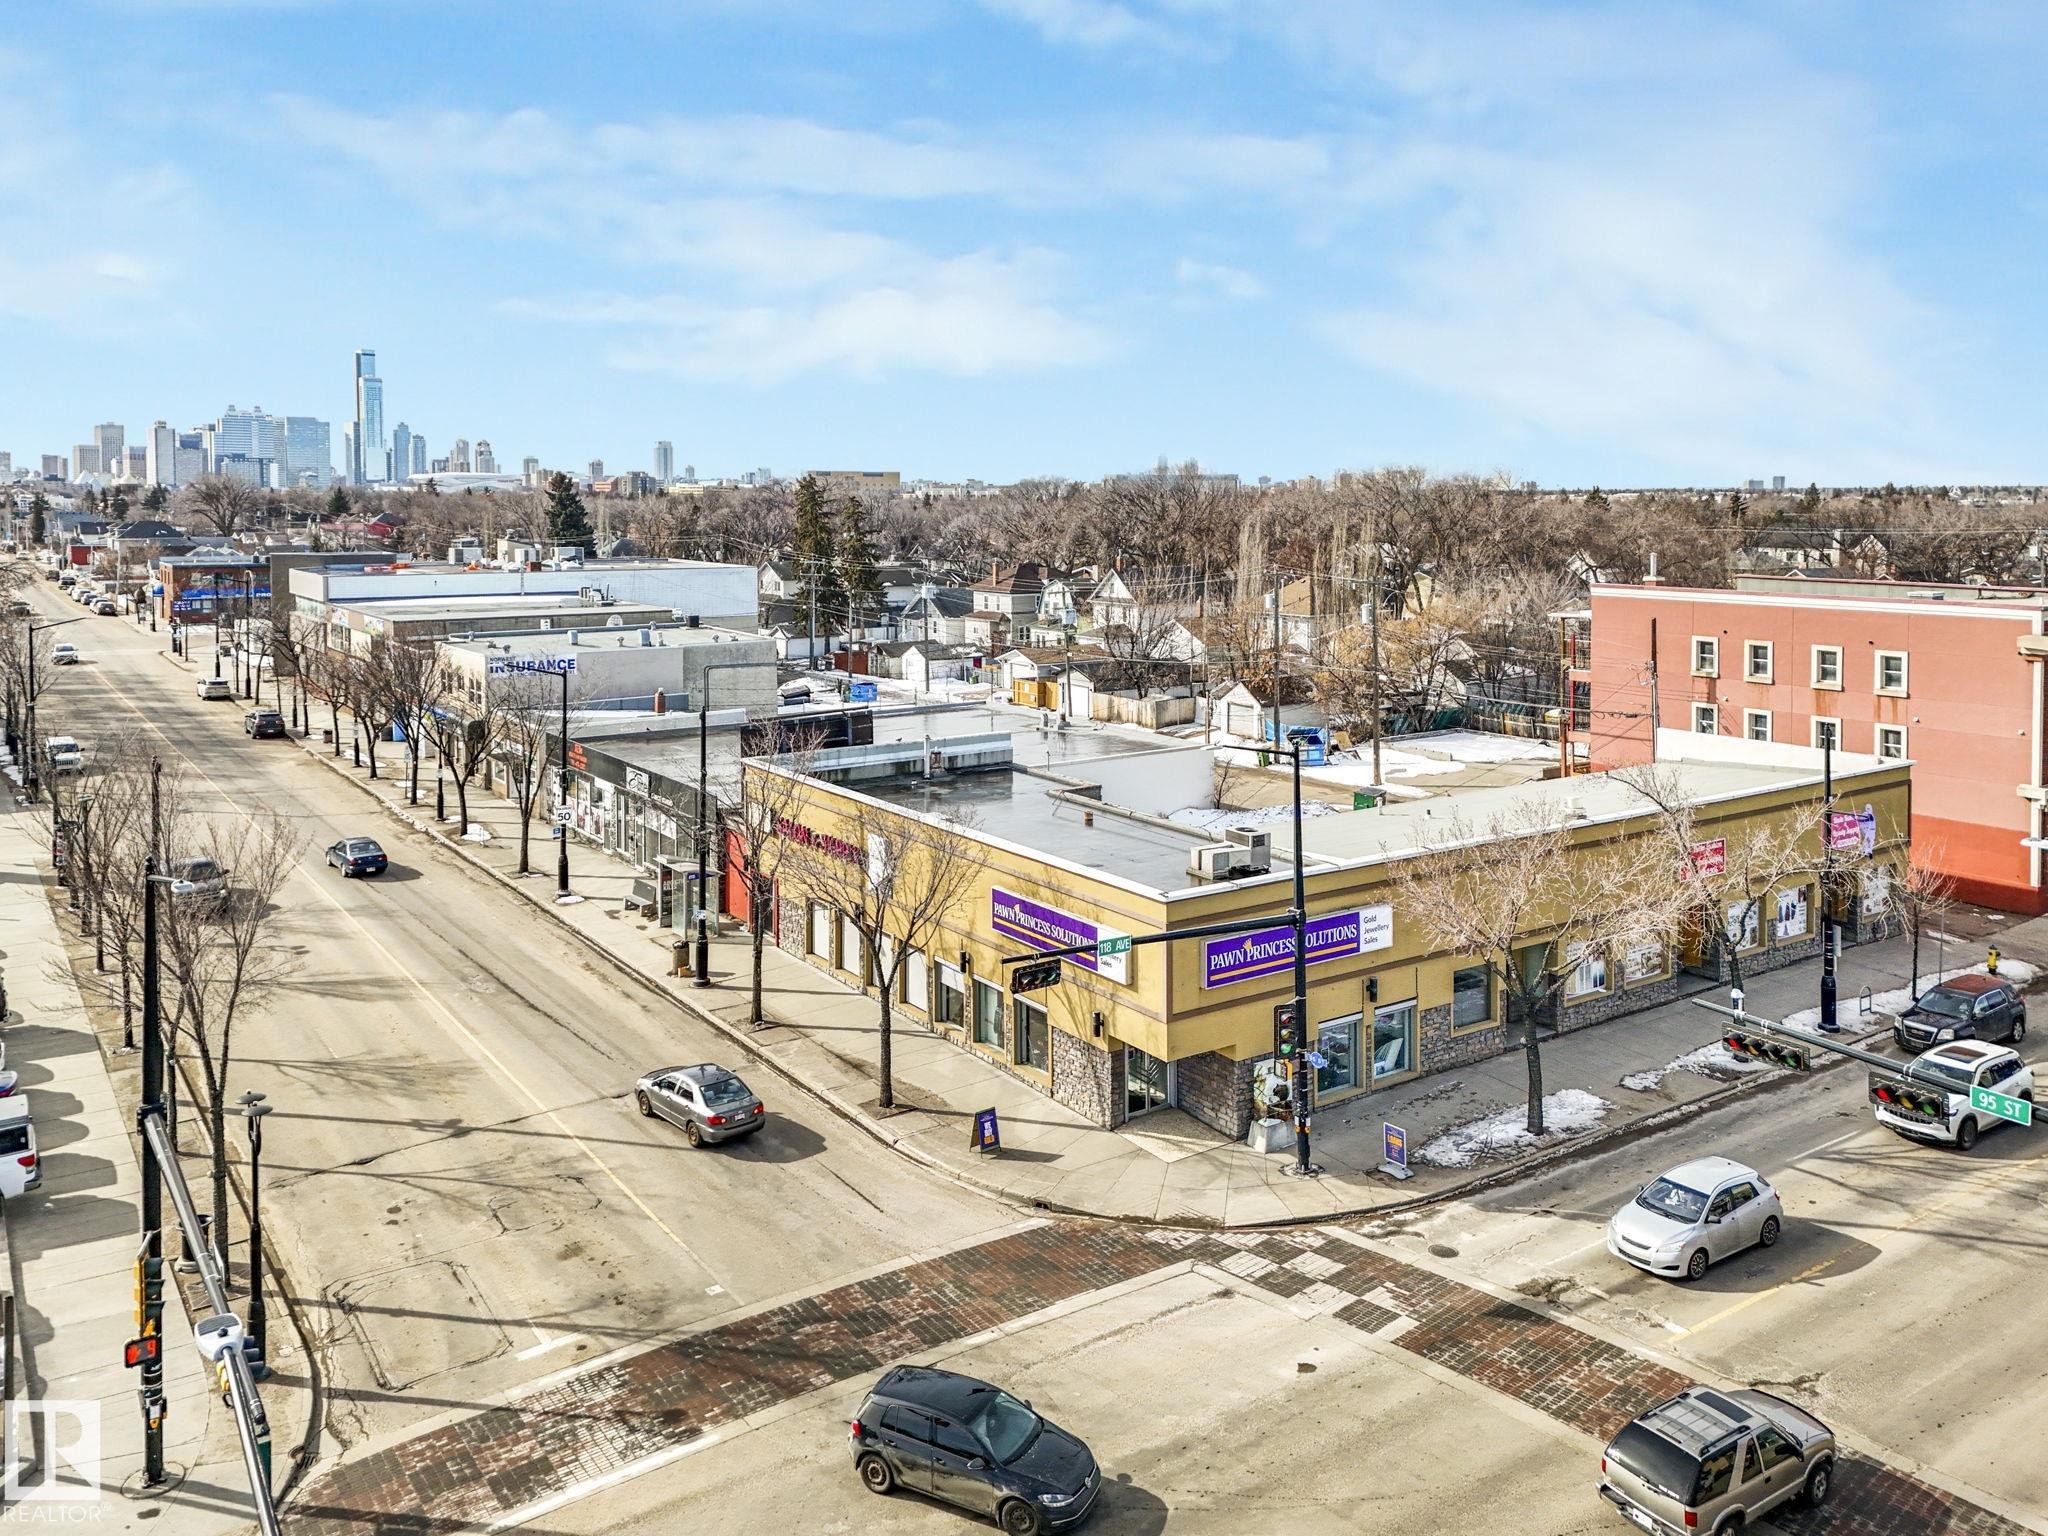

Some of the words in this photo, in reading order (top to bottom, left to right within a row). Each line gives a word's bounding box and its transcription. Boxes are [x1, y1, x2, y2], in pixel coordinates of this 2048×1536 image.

[558, 812, 571, 821] 50
[994, 902, 1015, 921] PAWN
[1016, 911, 1051, 936] PRINCESS
[1363, 914, 1377, 924] Gold
[1363, 922, 1390, 936] Jewellery
[1100, 942, 1112, 954] 118
[1115, 938, 1130, 951] AVE
[1210, 949, 1245, 970] PAWN
[1246, 937, 1296, 961] PRINCESS
[1306, 924, 1357, 947] OLUTIONS
[1363, 935, 1378, 945] Sales
[1978, 1093, 1996, 1109] 95
[2004, 1101, 2022, 1117] ST
